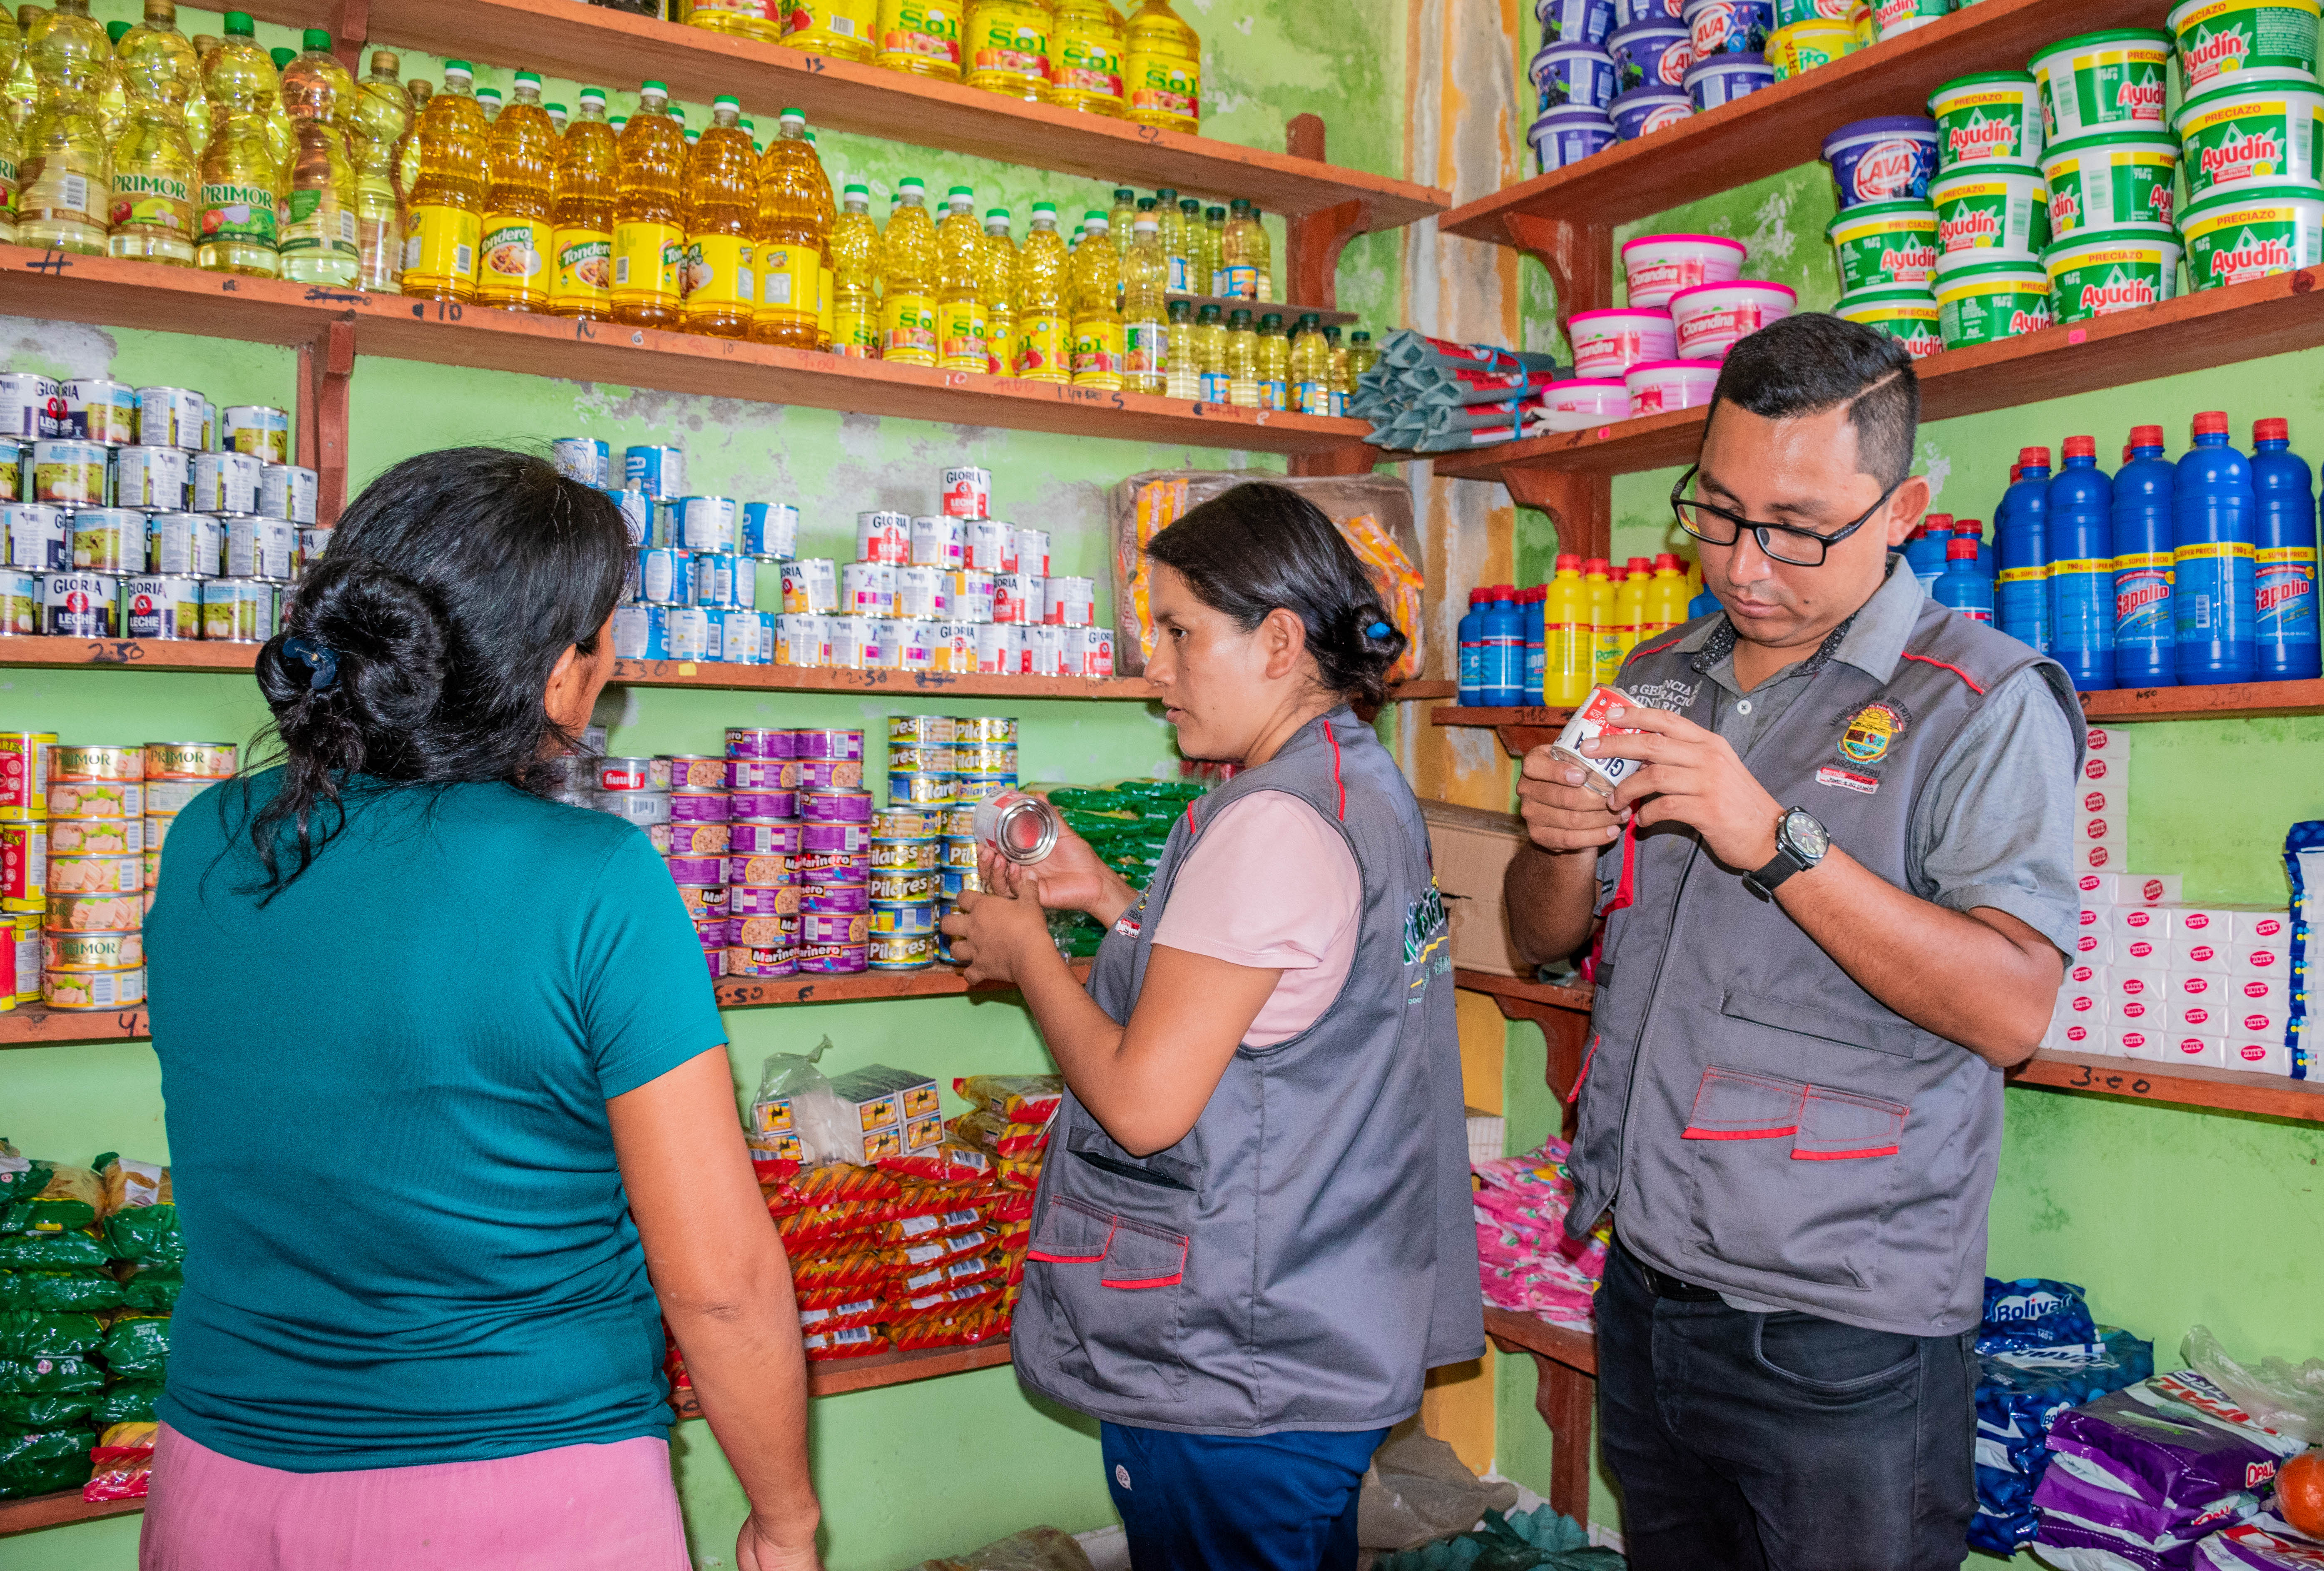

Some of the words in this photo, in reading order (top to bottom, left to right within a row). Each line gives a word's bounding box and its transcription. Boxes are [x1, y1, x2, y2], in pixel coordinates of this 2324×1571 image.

[2182, 3, 2227, 28] PRECIAZO
[900, 9, 956, 39] Sol
[989, 27, 1047, 54] Sol
[2184, 30, 2242, 72] Ayudín
[1063, 47, 1119, 75] Sol
[1146, 69, 1196, 97] Sol
[1954, 94, 2003, 107] PRECIAZO
[2205, 105, 2261, 123] PRECIAZO
[1949, 118, 2012, 151] Ayudín
[2201, 132, 2276, 172] Ayudín
[1857, 152, 1911, 187] LAVA
[111, 174, 187, 201] PRIMOR
[1943, 185, 1985, 200] PRECIAZO
[201, 184, 273, 209] PRIMOR
[2217, 211, 2276, 227] PRECIAZO
[1939, 209, 1996, 244] Ayudín
[2088, 251, 2143, 264] PRECIAZO
[2211, 240, 2289, 276] Ayudín
[1630, 265, 1678, 288] Clorandina
[2080, 279, 2153, 309] Ayudín
[1682, 313, 1734, 338] Clorandina
[946, 471, 982, 485] GLORIA
[873, 516, 907, 531] GLORIA
[781, 563, 802, 579] ORIA
[54, 579, 102, 597] GLORIA
[128, 583, 167, 599] GLORIA
[2117, 583, 2170, 622] Sapolio
[58, 612, 97, 626] LECHE
[130, 616, 159, 627] LECHE
[941, 626, 975, 640] GLORIA
[88, 642, 145, 662] 2.50
[1588, 710, 1601, 719] 50%
[2088, 735, 2106, 746] ZOTE
[53, 752, 111, 766] PRIMOR
[150, 751, 204, 764] PRIMOR
[2087, 764, 2106, 775] ZOTE
[2087, 796, 2105, 807] ZOTE
[2089, 822, 2107, 835] ZOTE
[2091, 851, 2108, 862] ZOTE
[871, 877, 927, 896] Pilares
[2081, 879, 2099, 888] ZOTE
[2145, 884, 2162, 896] ZOTE
[2130, 915, 2148, 924] ZOTE
[2187, 917, 2207, 926] ZOTE
[2258, 922, 2278, 933] ZOTE
[56, 941, 117, 955] PRIMOR
[870, 939, 926, 959] Pilares
[2132, 945, 2150, 954] ZOTE
[2192, 949, 2212, 959] ZOTE
[2252, 954, 2272, 964] ZOTE
[2074, 970, 2090, 978] ZOTE
[2186, 982, 2206, 990] ZOTE
[2246, 986, 2266, 994] ZOTE
[2125, 1005, 2143, 1014] ZOTE
[2187, 1012, 2206, 1021] ZOTE
[2246, 1018, 2267, 1027] ZOTE
[2069, 1030, 2085, 1038] ZOTE
[2125, 1036, 2143, 1044] ZOTE
[2182, 1042, 2202, 1051] ZOTE
[2242, 1049, 2263, 1058] ZOTE
[1996, 1293, 2072, 1322] Bolivar
[136, 1328, 150, 1337] 250
[2246, 1461, 2276, 1488] OPAL
